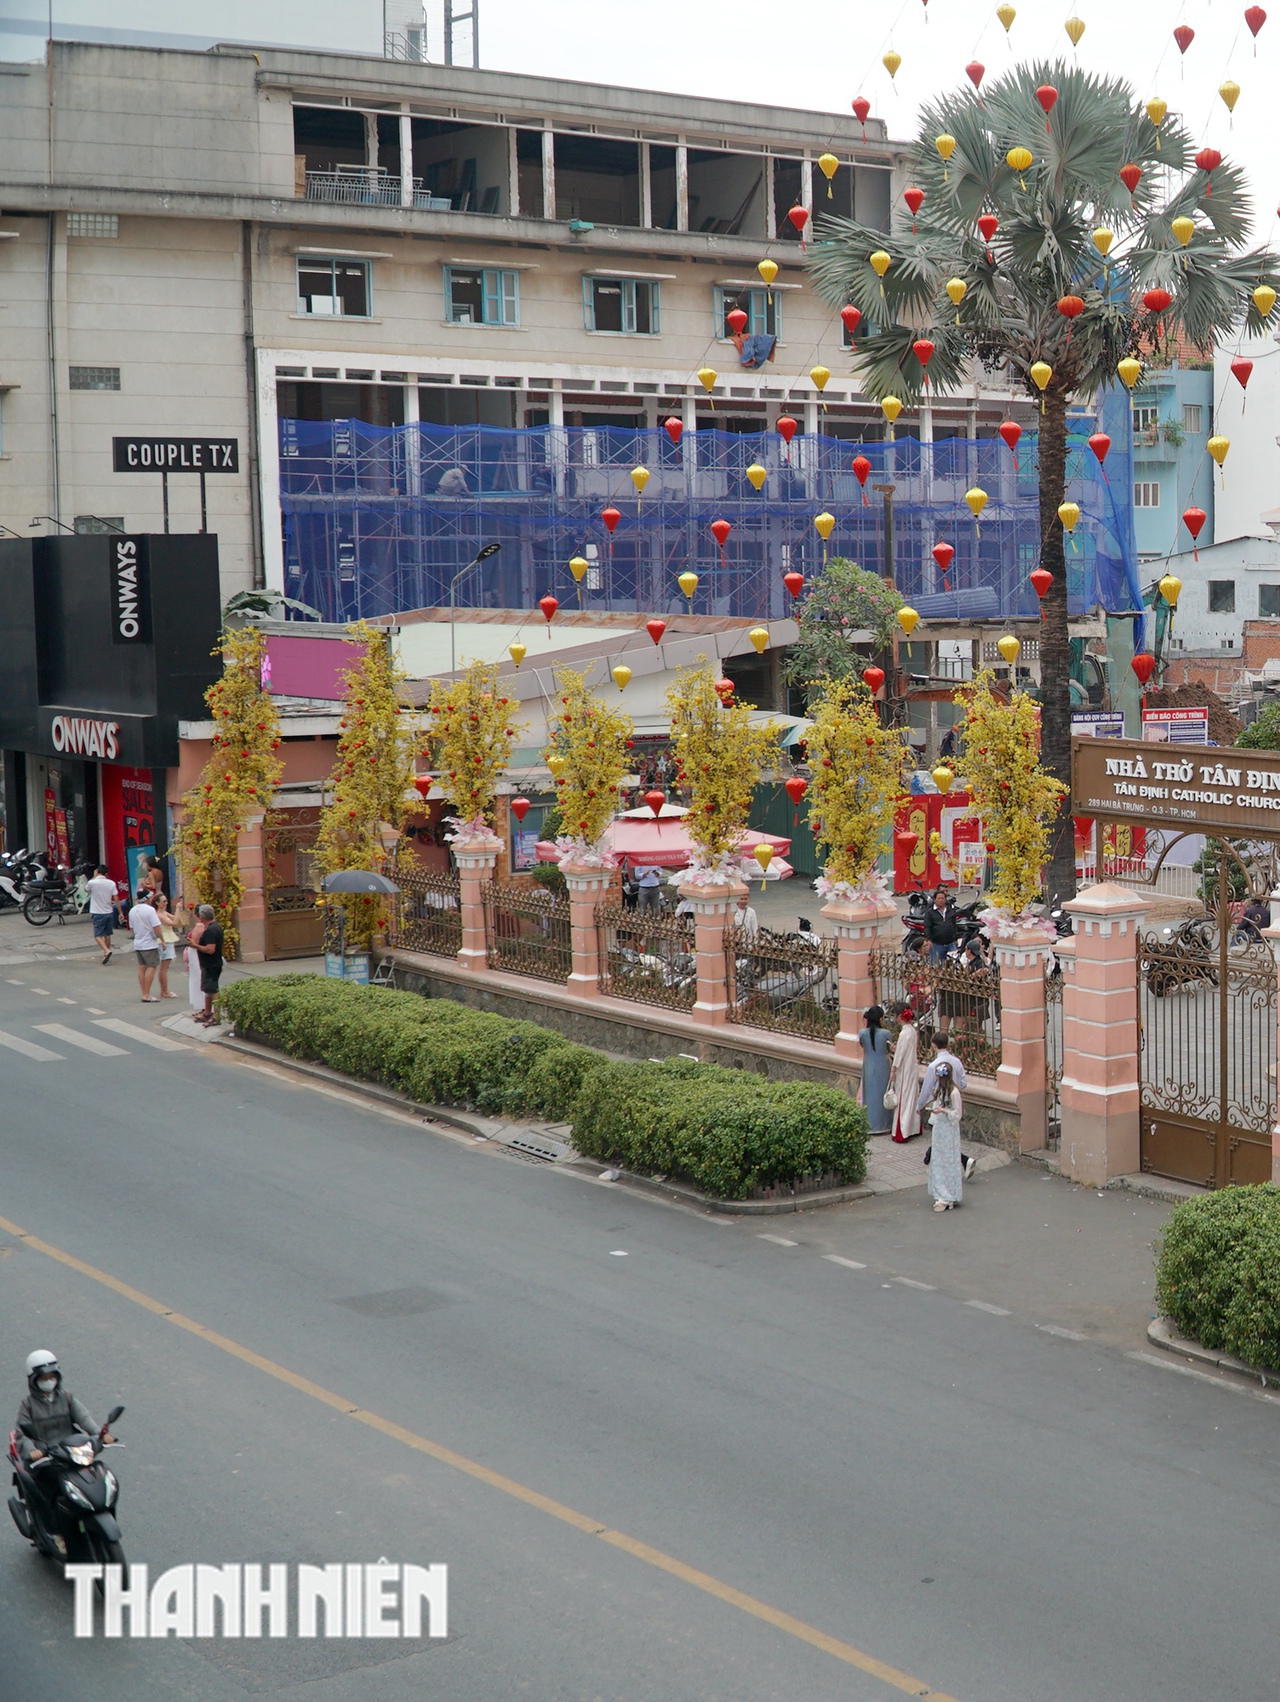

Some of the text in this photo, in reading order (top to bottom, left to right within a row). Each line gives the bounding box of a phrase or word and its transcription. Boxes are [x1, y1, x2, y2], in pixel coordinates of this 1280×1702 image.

[127, 443, 233, 468] COUPLE TX
[117, 541, 139, 638] ONWAYS
[1172, 710, 1188, 720] CÔNG
[1188, 710, 1204, 719] TRÌNH
[52, 715, 119, 760] ONWAYS
[1105, 754, 1148, 778] NHÀ
[1152, 758, 1194, 782] THỜ
[1199, 763, 1242, 787] TÂN
[1113, 781, 1137, 796] TÂN
[1139, 786, 1169, 800] ĐỊNH
[1172, 788, 1234, 806] CATHOLIC
[1088, 798, 1100, 808] 289
[1101, 800, 1112, 809] HAI
[1112, 799, 1122, 810] BÀ
[1181, 809, 1197, 819] HCM
